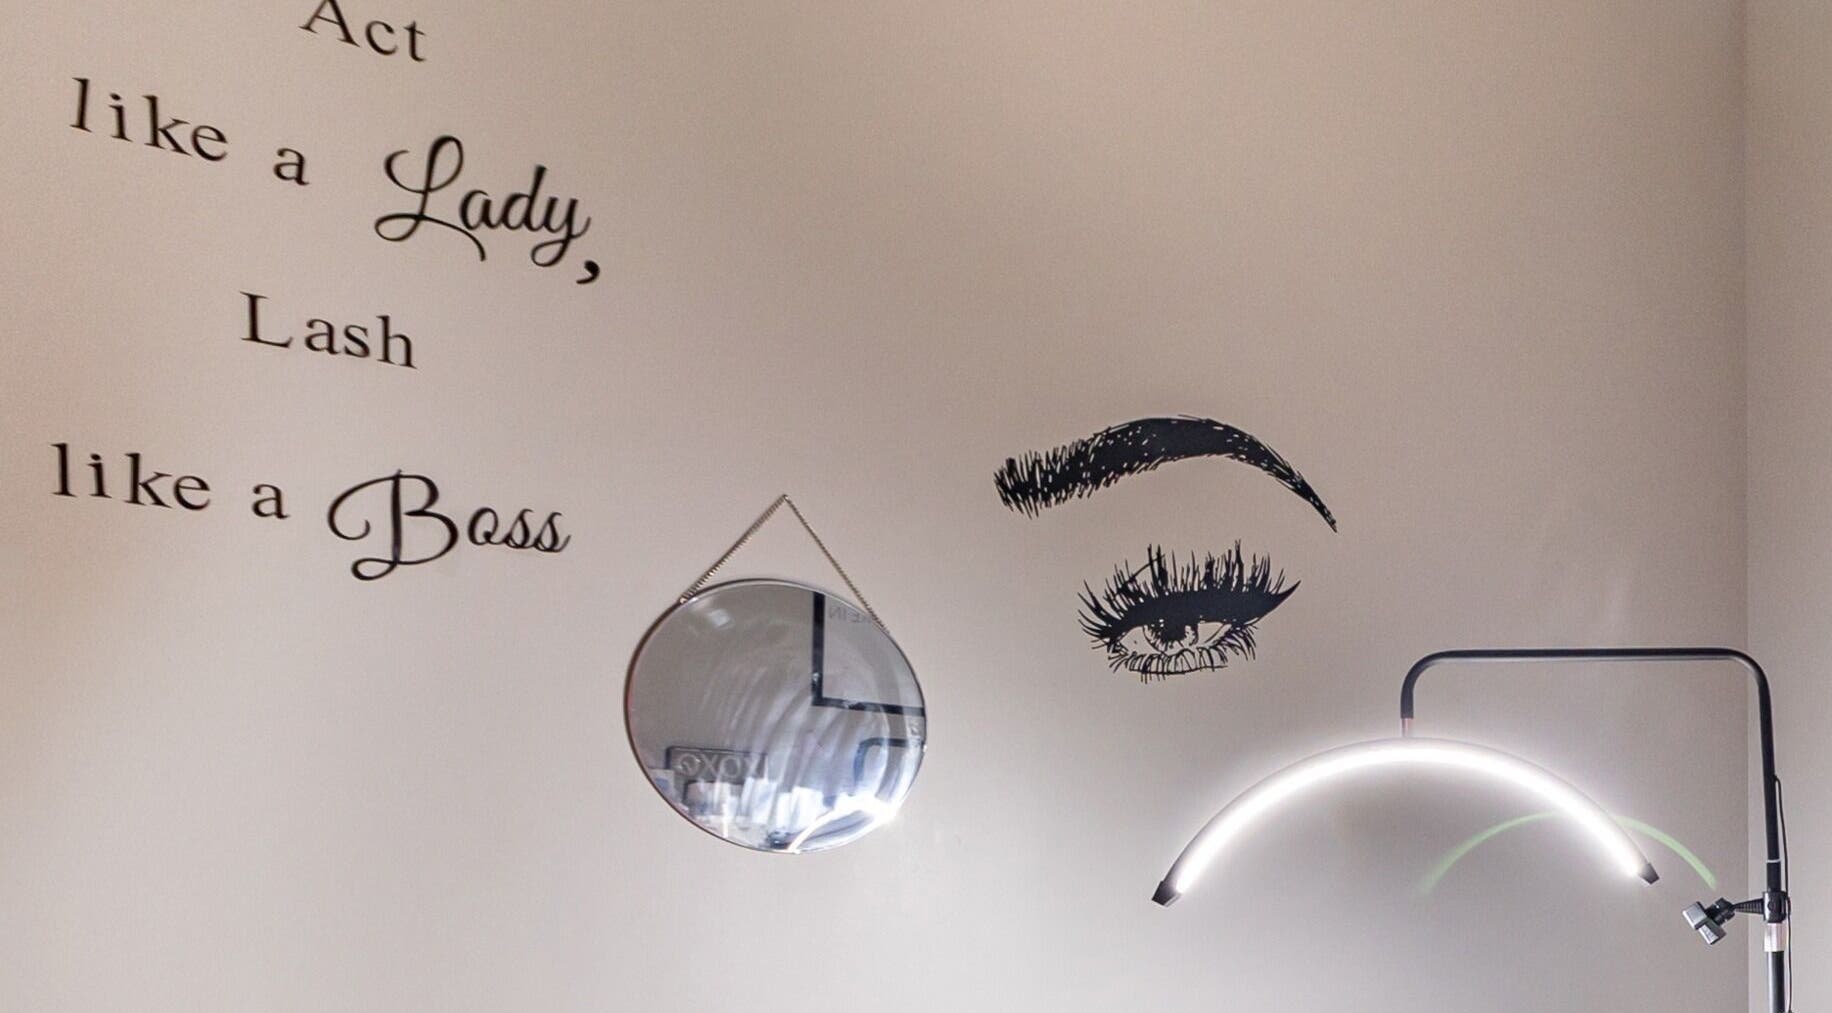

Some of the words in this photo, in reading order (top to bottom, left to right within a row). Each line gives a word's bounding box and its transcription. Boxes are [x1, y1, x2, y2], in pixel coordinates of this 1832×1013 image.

[301, 0, 427, 62] Act
[70, 77, 229, 162] like
[273, 146, 310, 187] a
[373, 135, 601, 285] Lady,
[240, 291, 418, 370] Lash
[51, 443, 212, 512] like
[251, 482, 291, 520] a
[327, 468, 572, 581] Boss
